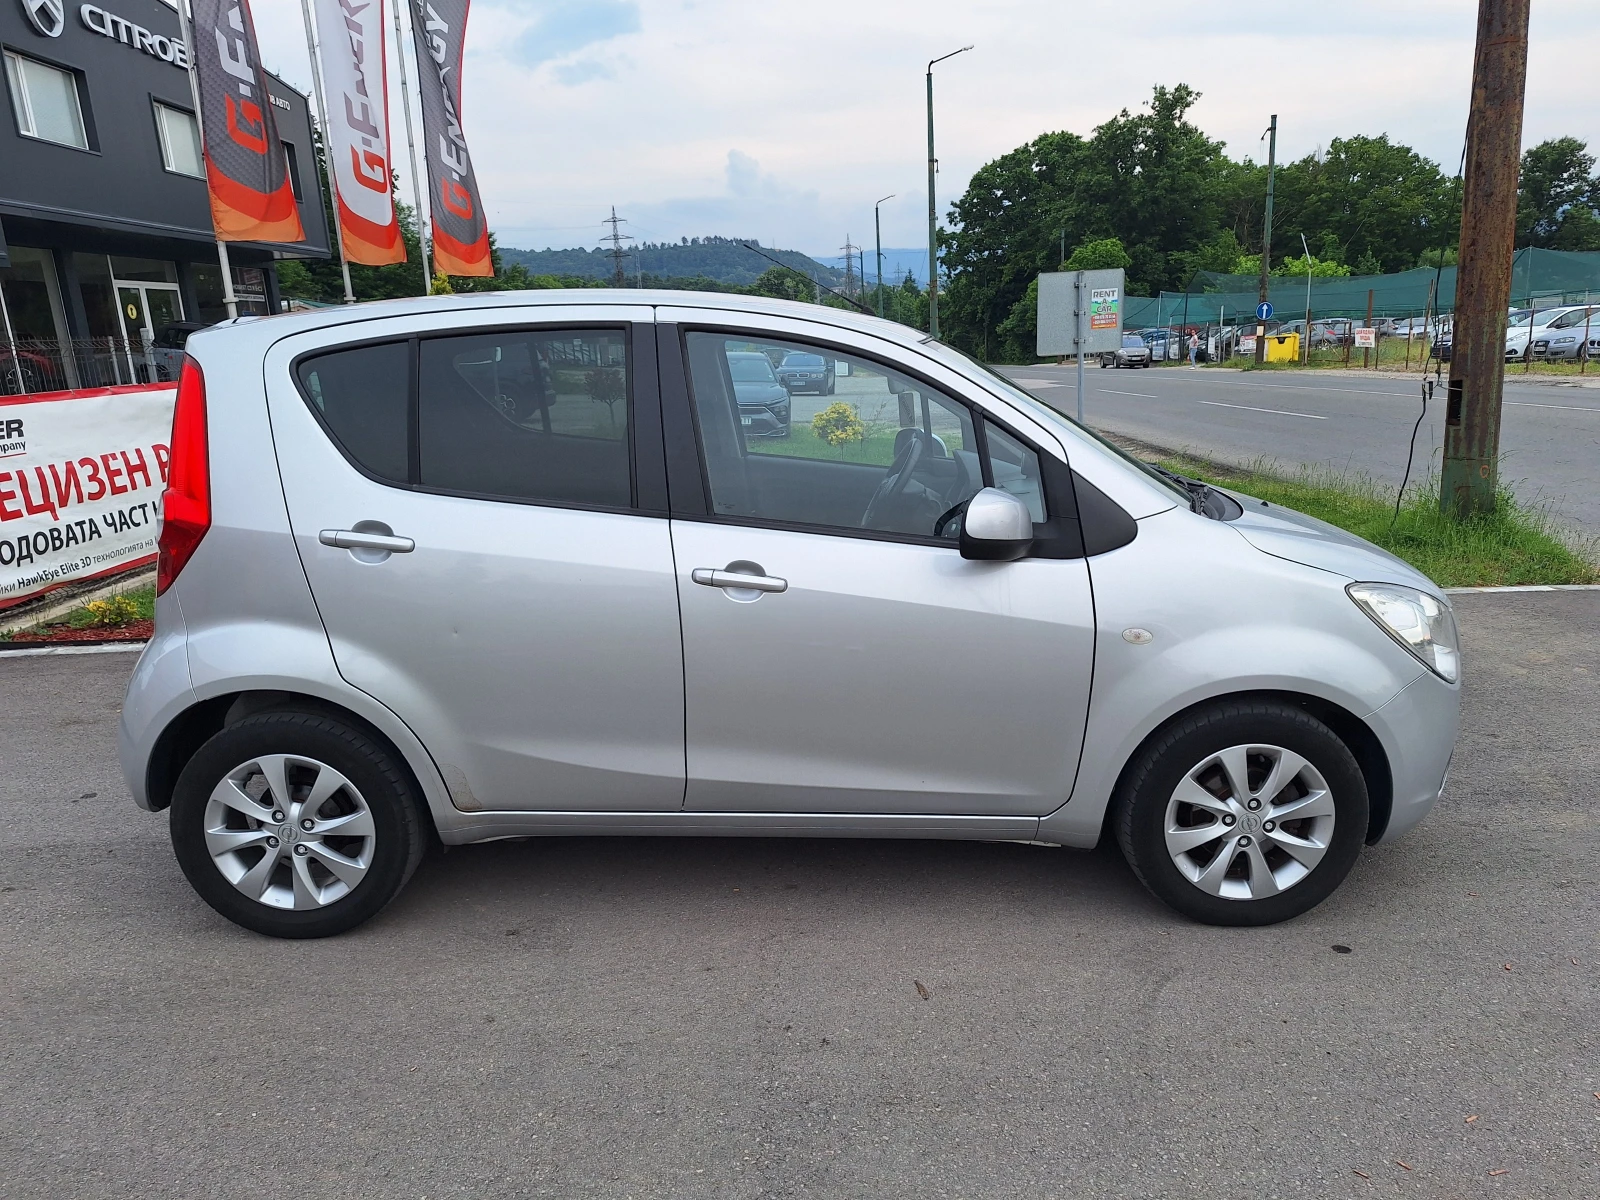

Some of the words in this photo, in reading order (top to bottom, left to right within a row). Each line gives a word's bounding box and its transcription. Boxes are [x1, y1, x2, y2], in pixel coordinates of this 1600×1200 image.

[81, 4, 189, 69] CITROË
[1093, 290, 1116, 298] RENT
[0, 448, 151, 521] ЕЦИЗЕН
[0, 517, 102, 567] ОДОВАТА
[102, 502, 149, 533] ЧАСТ
[17, 569, 60, 588] HawkEye
[60, 562, 80, 575] Elite
[80, 556, 92, 568] 3D
[92, 542, 143, 563] технологията
[144, 538, 153, 547] на
